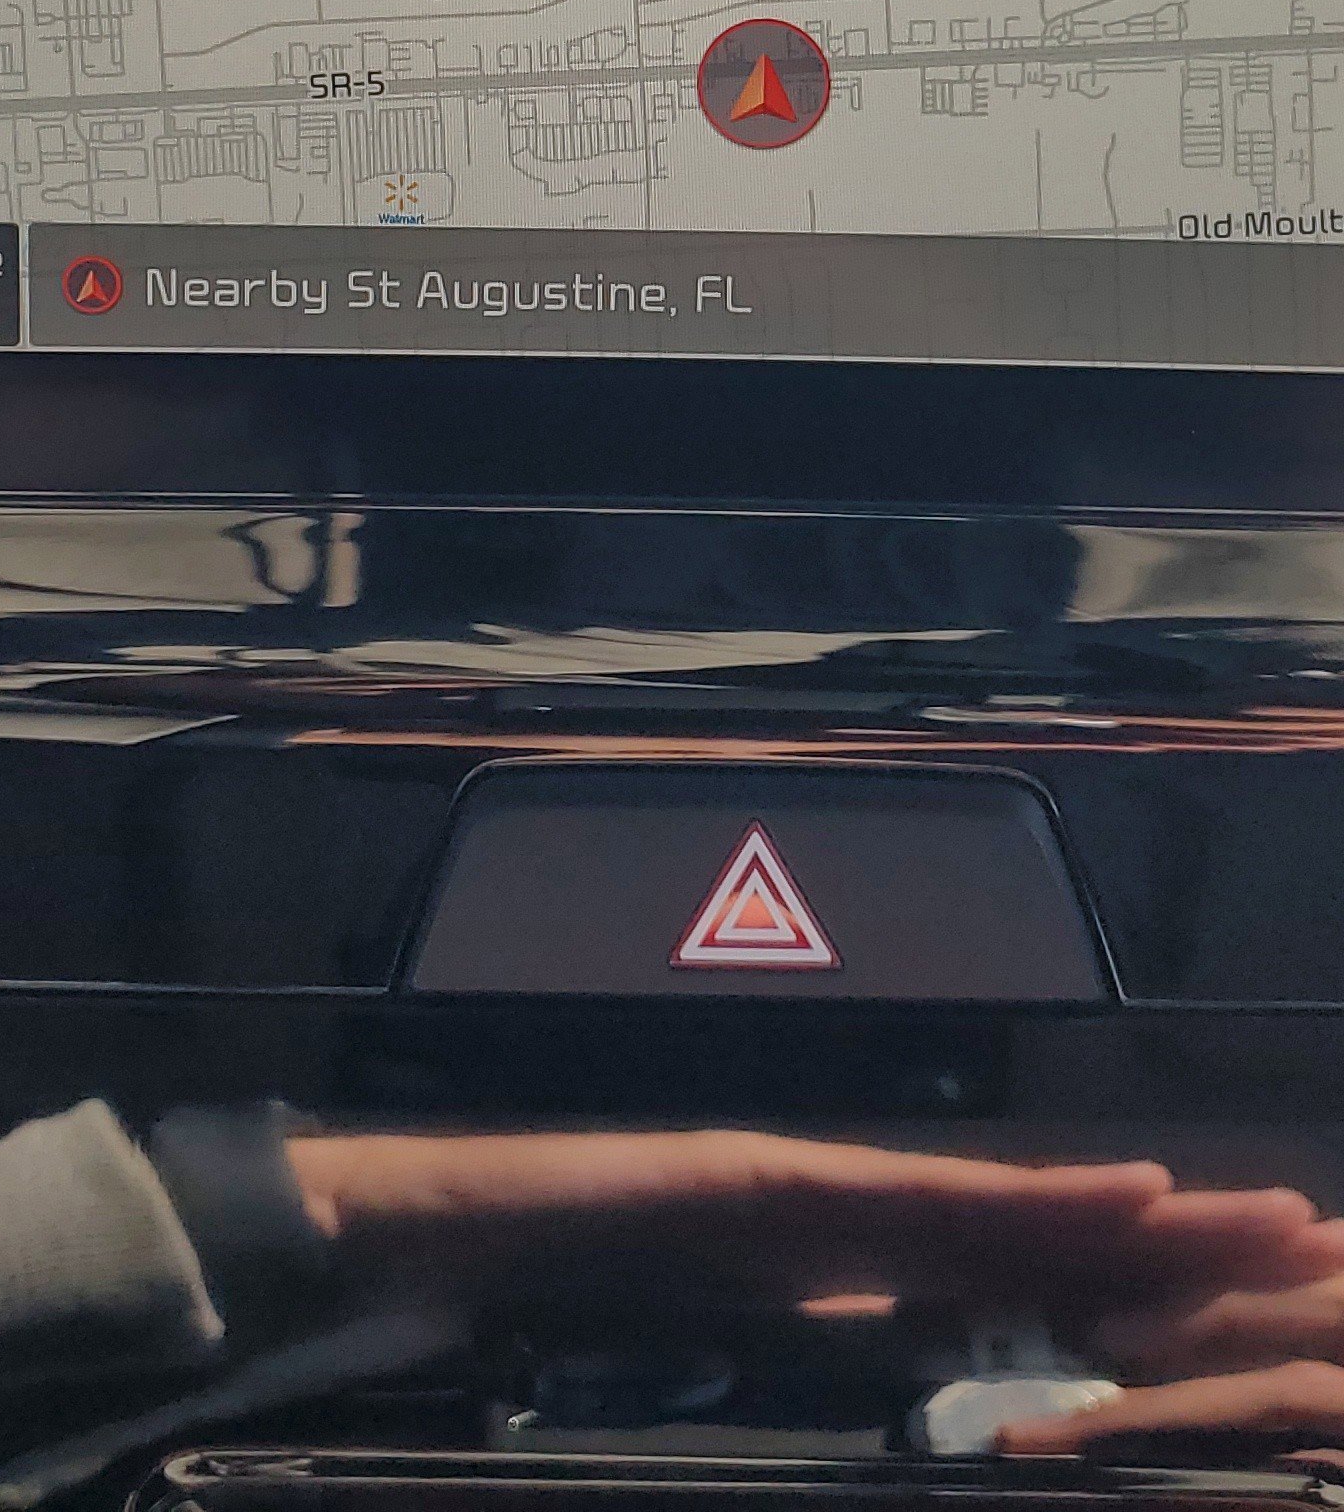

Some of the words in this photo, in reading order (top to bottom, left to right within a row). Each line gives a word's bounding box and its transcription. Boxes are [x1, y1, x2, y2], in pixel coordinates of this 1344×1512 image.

[310, 71, 385, 99] SR-5
[378, 213, 425, 225] Walmart
[1178, 213, 1232, 239] Old
[145, 268, 328, 314] Nearby
[347, 270, 402, 309] St
[416, 272, 678, 318] Augustine,
[695, 275, 753, 314] FL
